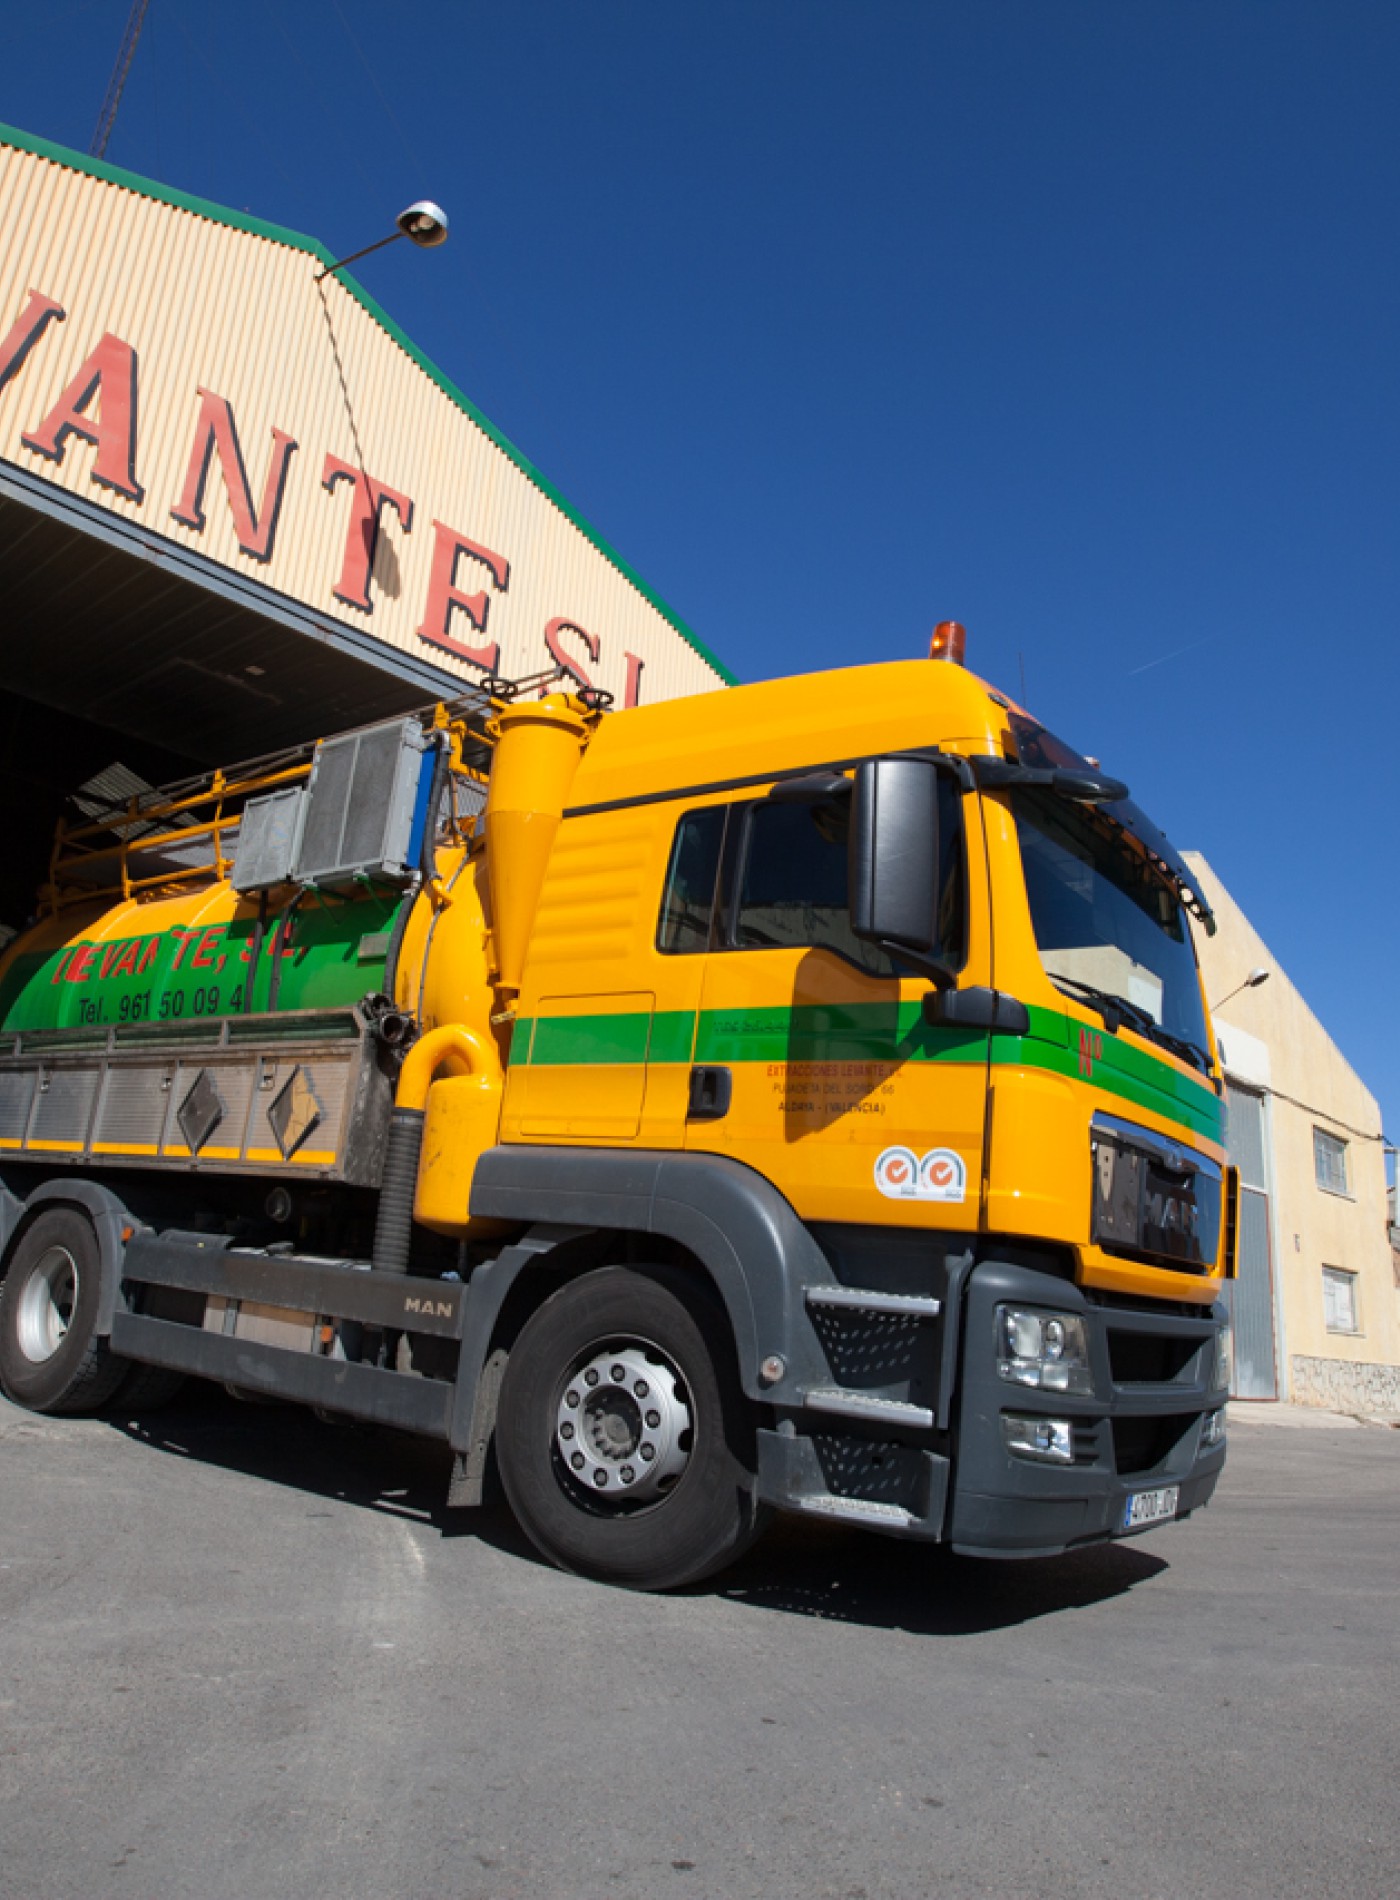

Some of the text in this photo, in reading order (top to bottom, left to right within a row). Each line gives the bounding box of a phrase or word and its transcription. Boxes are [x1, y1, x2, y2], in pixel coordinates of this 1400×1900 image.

[79, 996, 109, 1024] Tel.
[118, 987, 152, 1021] 961
[158, 989, 185, 1017] 50
[193, 985, 220, 1015] 09
[403, 1296, 453, 1318] MAN
